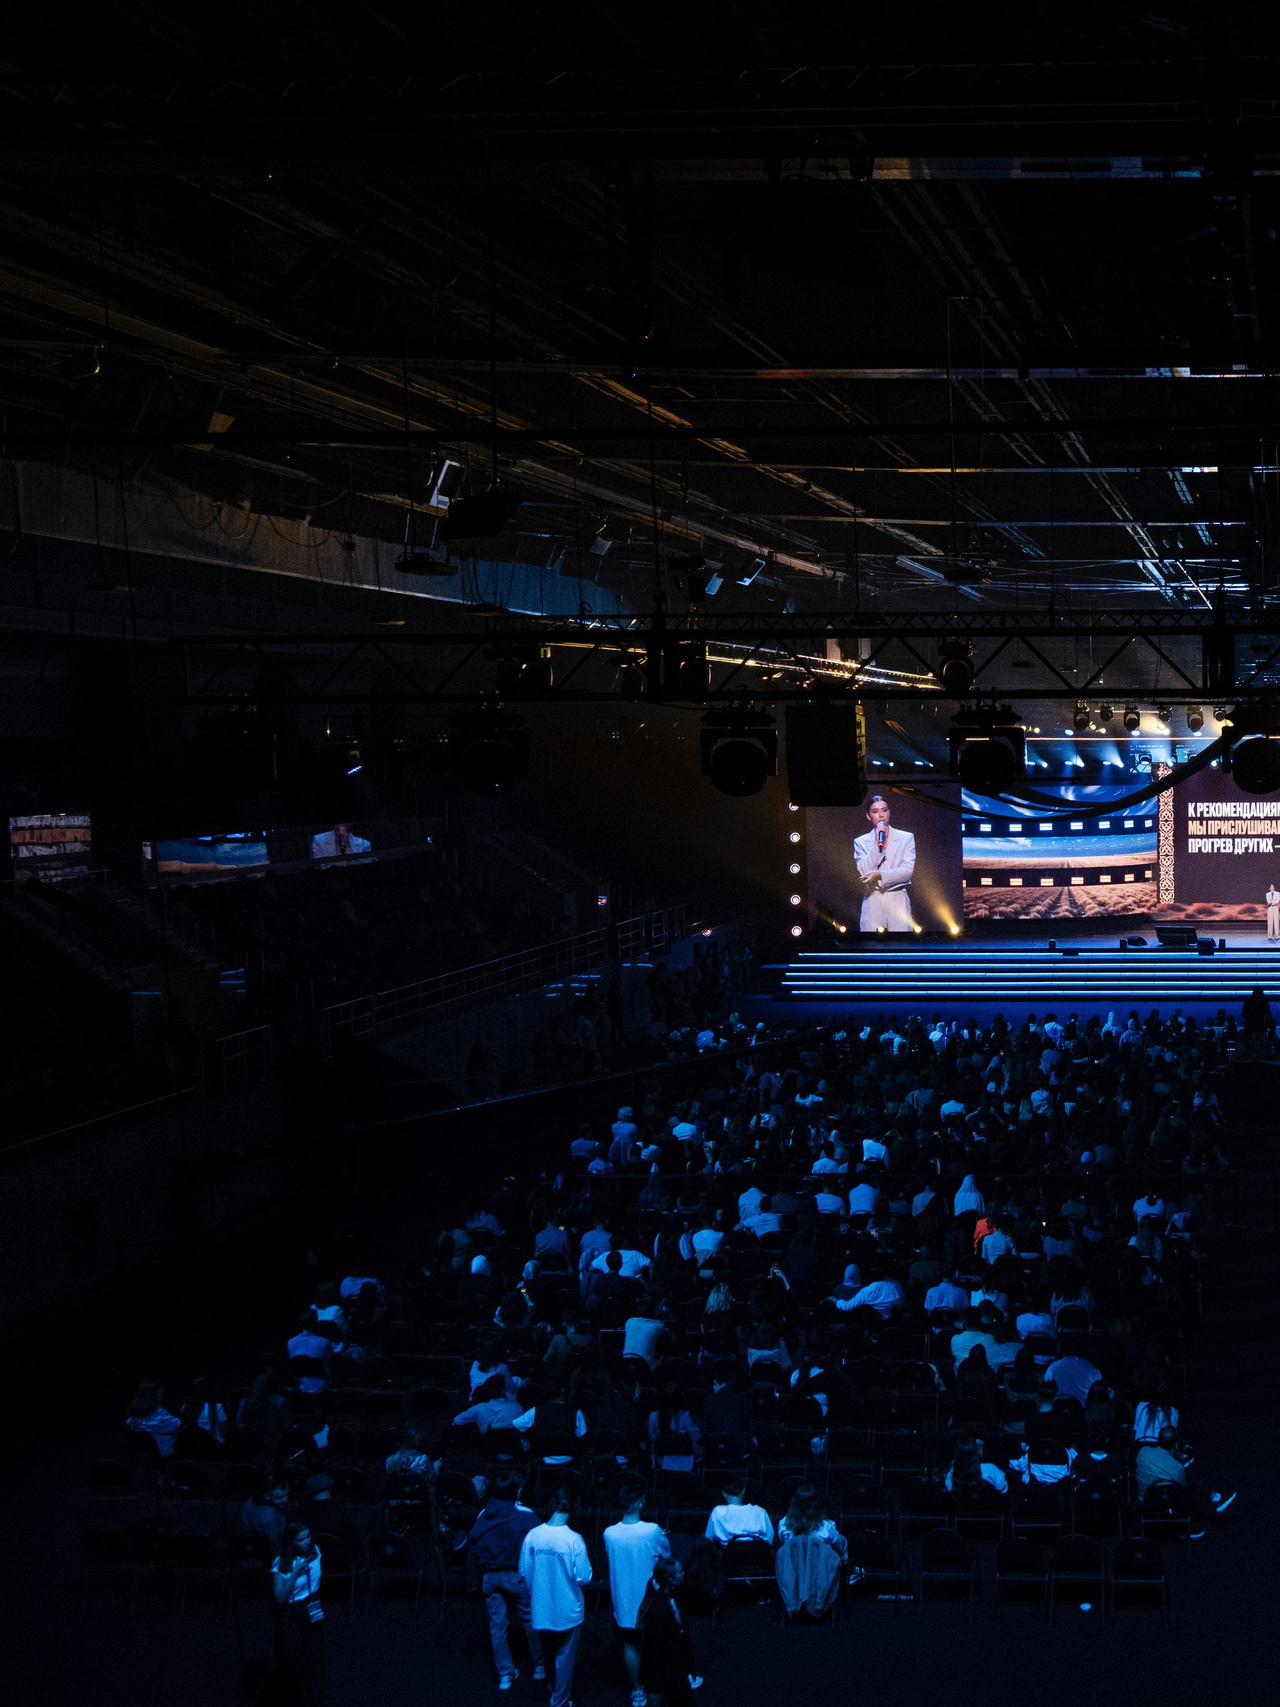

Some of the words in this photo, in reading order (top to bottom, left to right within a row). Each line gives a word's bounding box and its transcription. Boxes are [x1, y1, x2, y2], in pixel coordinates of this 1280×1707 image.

[1188, 802, 1195, 817] К
[1188, 820, 1207, 835] МЫ
[1188, 838, 1233, 853] ПРОГРЕВ
[1234, 838, 1273, 855] ДРУГИХ
